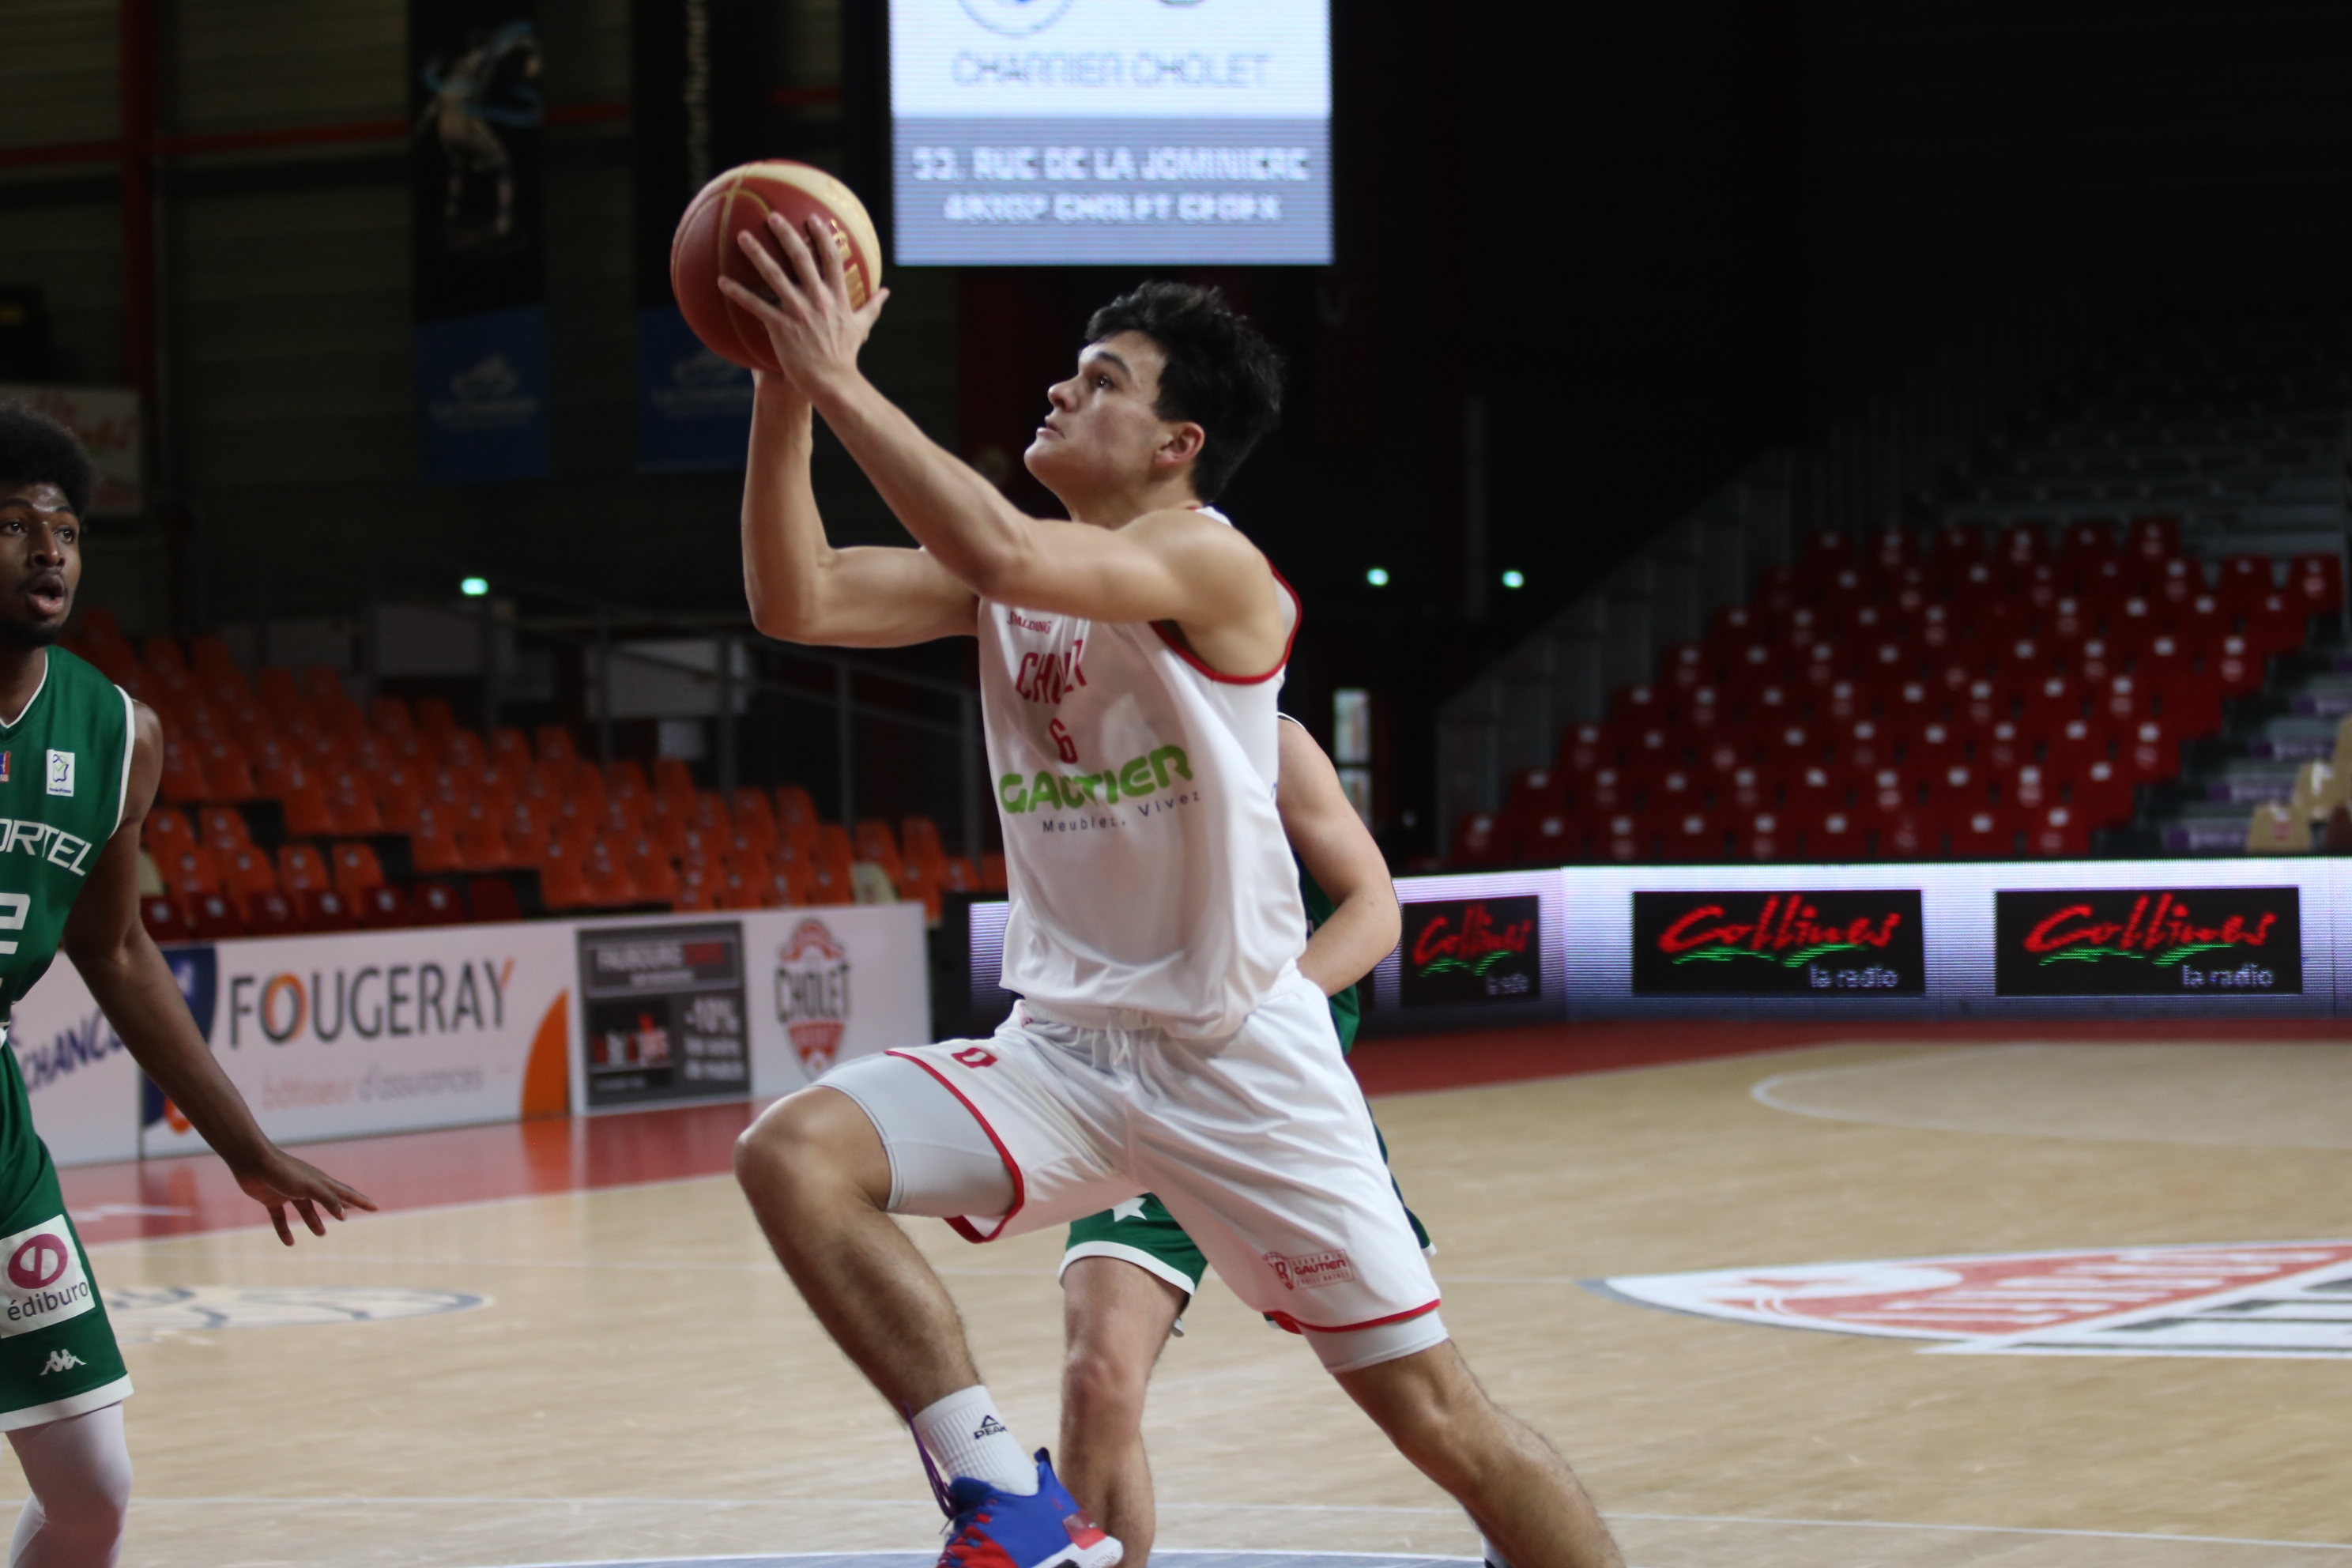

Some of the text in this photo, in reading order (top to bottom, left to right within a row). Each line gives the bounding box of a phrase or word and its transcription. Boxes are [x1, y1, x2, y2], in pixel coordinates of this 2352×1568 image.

[1130, 51, 1269, 88] CHOLET
[972, 146, 1037, 181] RUE
[1094, 146, 1135, 181] LA
[1007, 612, 1052, 635] SPALDING
[1048, 718, 1078, 764] 6
[999, 744, 1193, 814] GAUTIER
[1658, 895, 1902, 952] Collines
[2023, 894, 2277, 952] Collines
[1810, 963, 1898, 987] la radio
[2182, 963, 2275, 987] la radio
[229, 958, 514, 1050] FOUGERAY
[7, 1281, 89, 1321] édiburo
[974, 1426, 1008, 1440] PEAK
